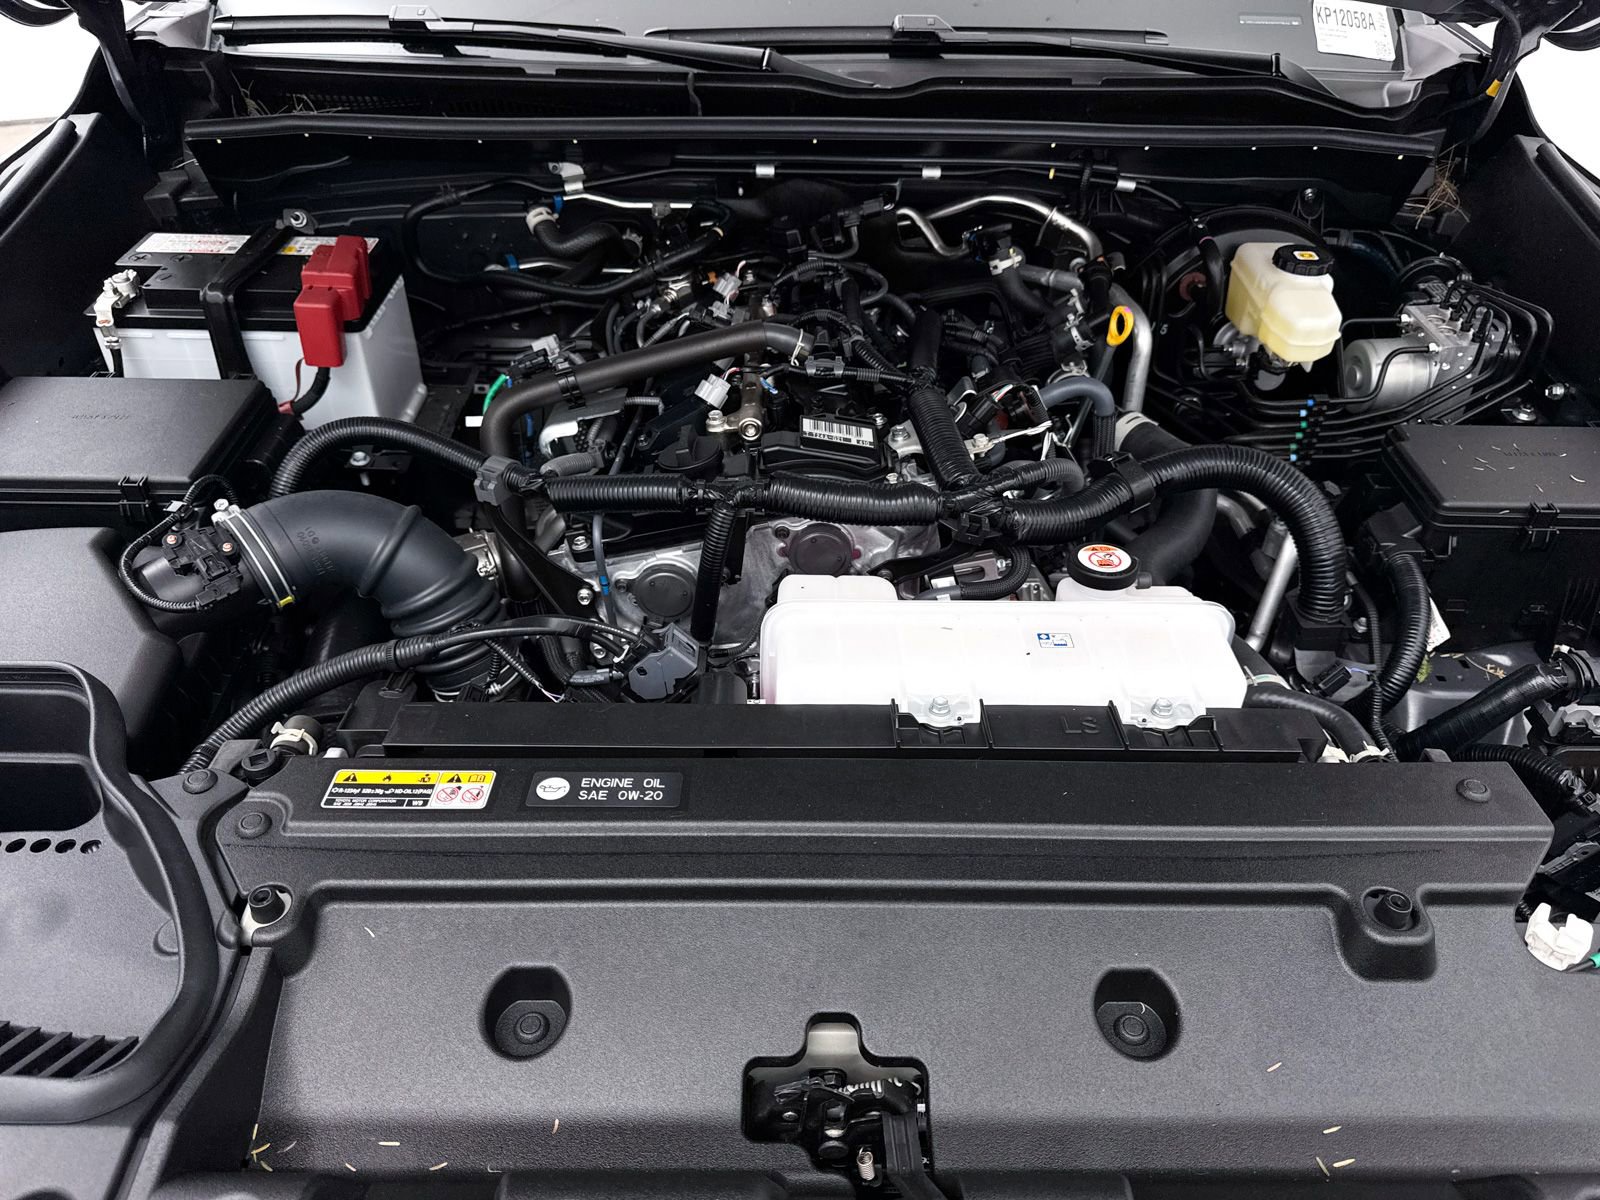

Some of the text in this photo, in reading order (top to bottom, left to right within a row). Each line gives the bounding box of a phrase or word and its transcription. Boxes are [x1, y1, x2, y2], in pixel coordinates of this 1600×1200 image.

[1315, 5, 1376, 31] KP12058A
[580, 777, 665, 788] ENGINE OIL
[578, 790, 663, 801] SAE 0W-20
